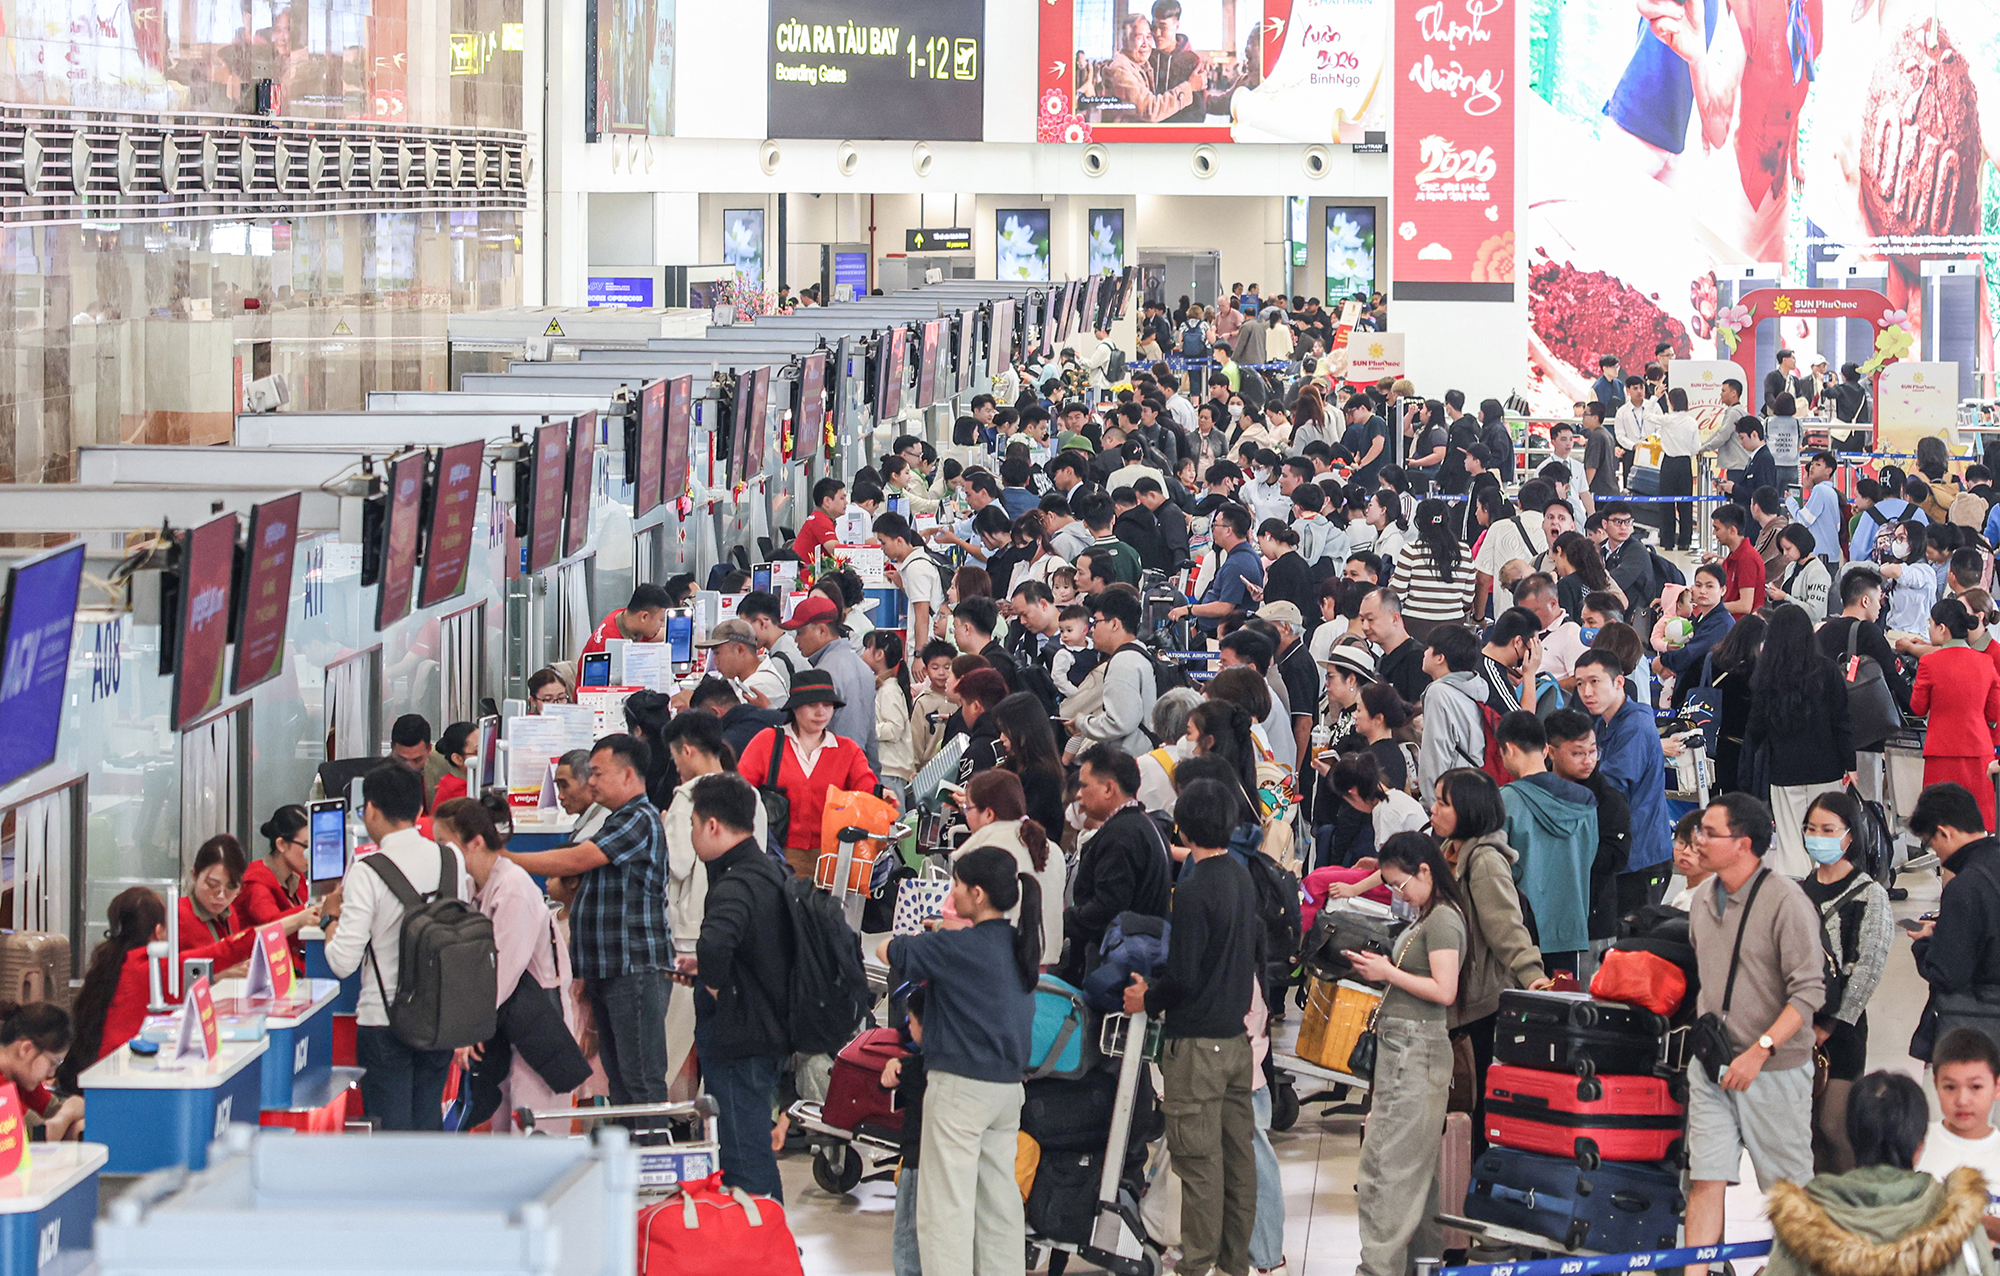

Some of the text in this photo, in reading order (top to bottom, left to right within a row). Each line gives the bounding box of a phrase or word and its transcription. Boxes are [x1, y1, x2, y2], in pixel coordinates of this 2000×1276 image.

[776, 17, 900, 56] CỬA RA TÀU BAY
[1415, 0, 1491, 51] Thịnh
[906, 34, 950, 80] 1-12
[1317, 49, 1359, 70] 2026
[775, 62, 847, 86] Boarding Gates
[1408, 54, 1504, 116] Vượng
[1415, 134, 1497, 186] 2026
[1794, 299, 1858, 309] SUN PhuQuoc
[92, 618, 120, 703] A08
[1629, 1254, 1651, 1268] ACV
[1696, 1247, 1719, 1260] ACV
[1491, 1266, 1513, 1276] ACV
[1560, 1261, 1583, 1274] ACV
